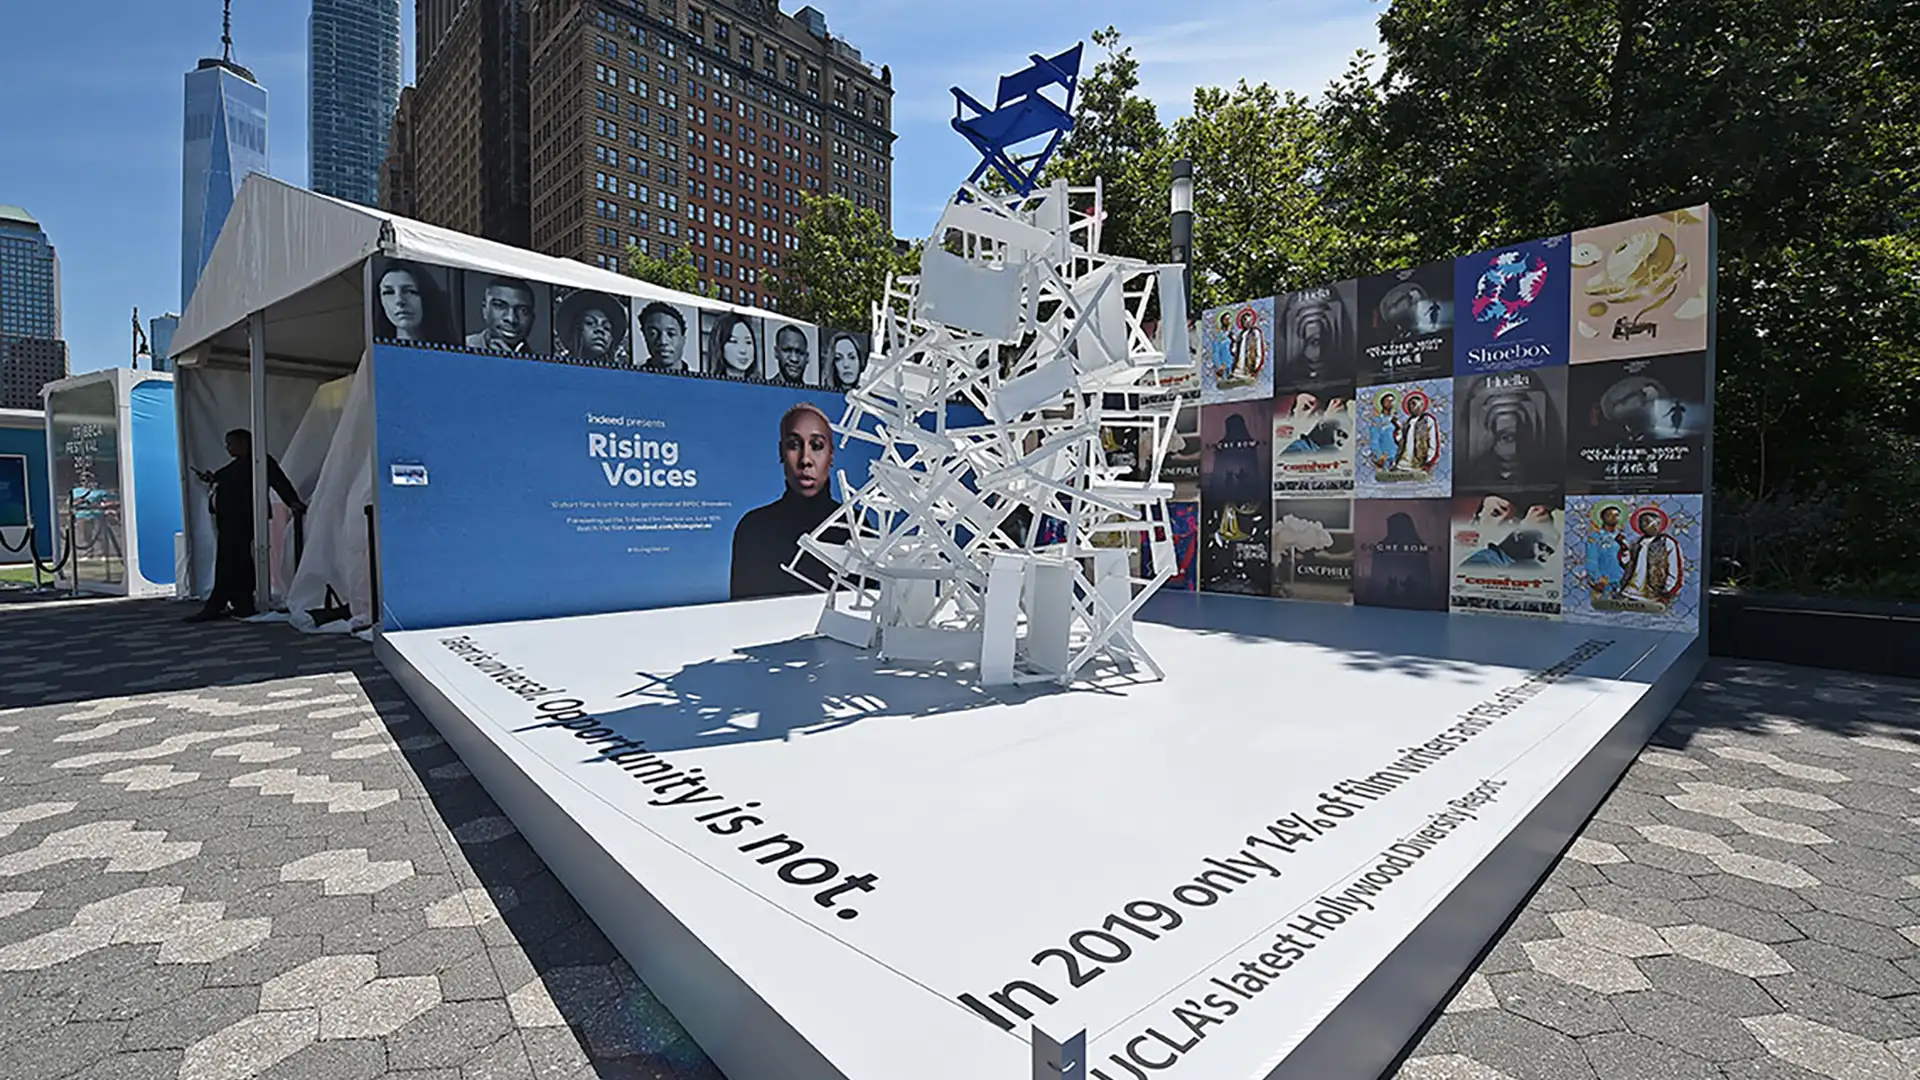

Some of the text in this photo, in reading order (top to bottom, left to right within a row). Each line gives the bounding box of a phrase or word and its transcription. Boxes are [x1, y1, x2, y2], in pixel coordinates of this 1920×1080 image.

[1467, 343, 1552, 364] Shoebox
[626, 417, 666, 429] presents
[588, 432, 679, 467] Rising
[602, 460, 698, 487] Voices
[1297, 564, 1351, 577] CINEPHILE
[1385, 732, 1468, 773] writers
[1316, 792, 1366, 819] of
[1333, 778, 1410, 801] film
[536, 698, 725, 806] Opportunity
[694, 801, 764, 835] is
[737, 833, 880, 920] not.
[1246, 812, 1338, 853] 14%
[1172, 849, 1282, 907] only
[1209, 933, 1317, 999] latest
[1286, 852, 1416, 940] Hollywood
[1388, 807, 1478, 859] Diversity
[1031, 900, 1183, 988] 2019
[957, 980, 1060, 1031] In
